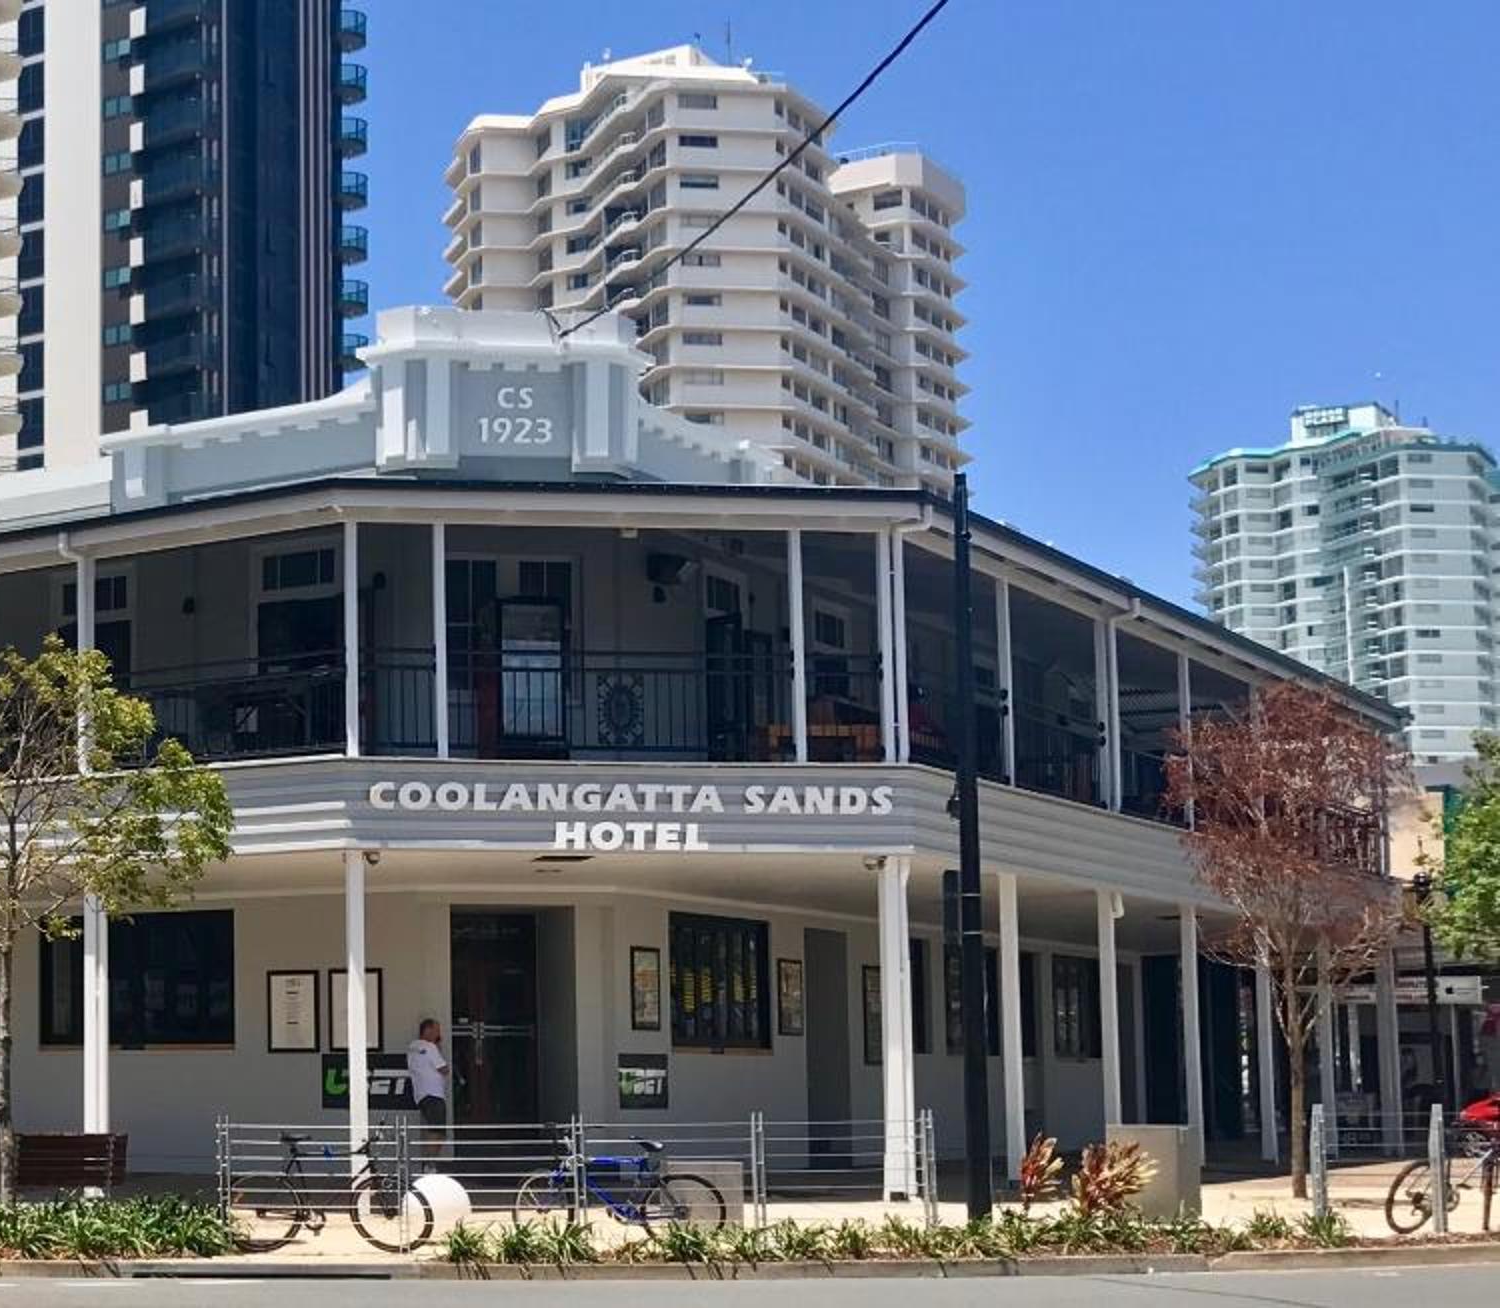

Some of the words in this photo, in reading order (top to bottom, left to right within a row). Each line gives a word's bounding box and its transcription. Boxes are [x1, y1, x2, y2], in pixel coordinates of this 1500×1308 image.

[497, 386, 533, 409] CS
[479, 416, 552, 444] 1923
[368, 780, 725, 812] COOLANGATTA
[743, 785, 894, 816] SANDS
[553, 820, 709, 852] HOTEL
[324, 1067, 412, 1096] UET
